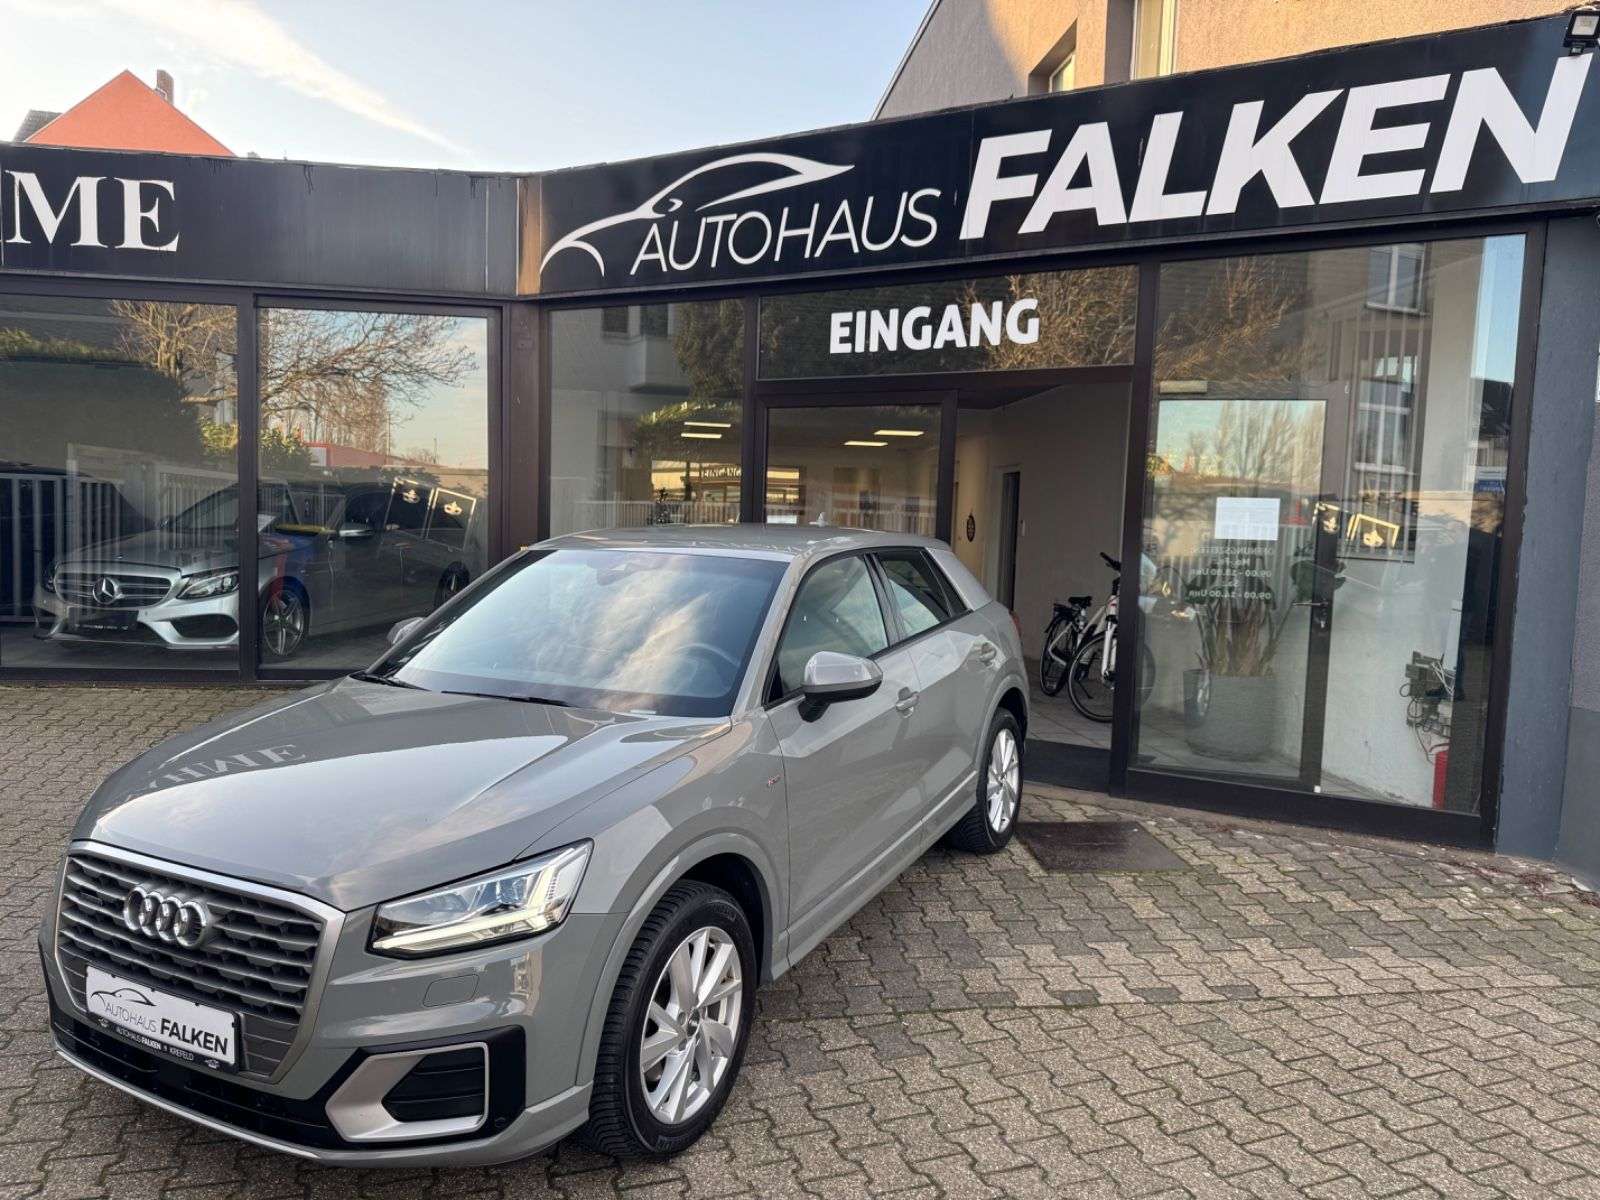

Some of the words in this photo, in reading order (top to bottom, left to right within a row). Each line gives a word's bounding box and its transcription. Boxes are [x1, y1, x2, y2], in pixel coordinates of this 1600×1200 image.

[630, 187, 942, 276] AUTOHAUS
[958, 53, 1595, 241] FALKEN
[829, 298, 1040, 355] EINGANG
[104, 1002, 157, 1033] AUTOHAUS
[160, 1017, 229, 1056] FALKEN
[142, 1037, 161, 1050] FALKEN
